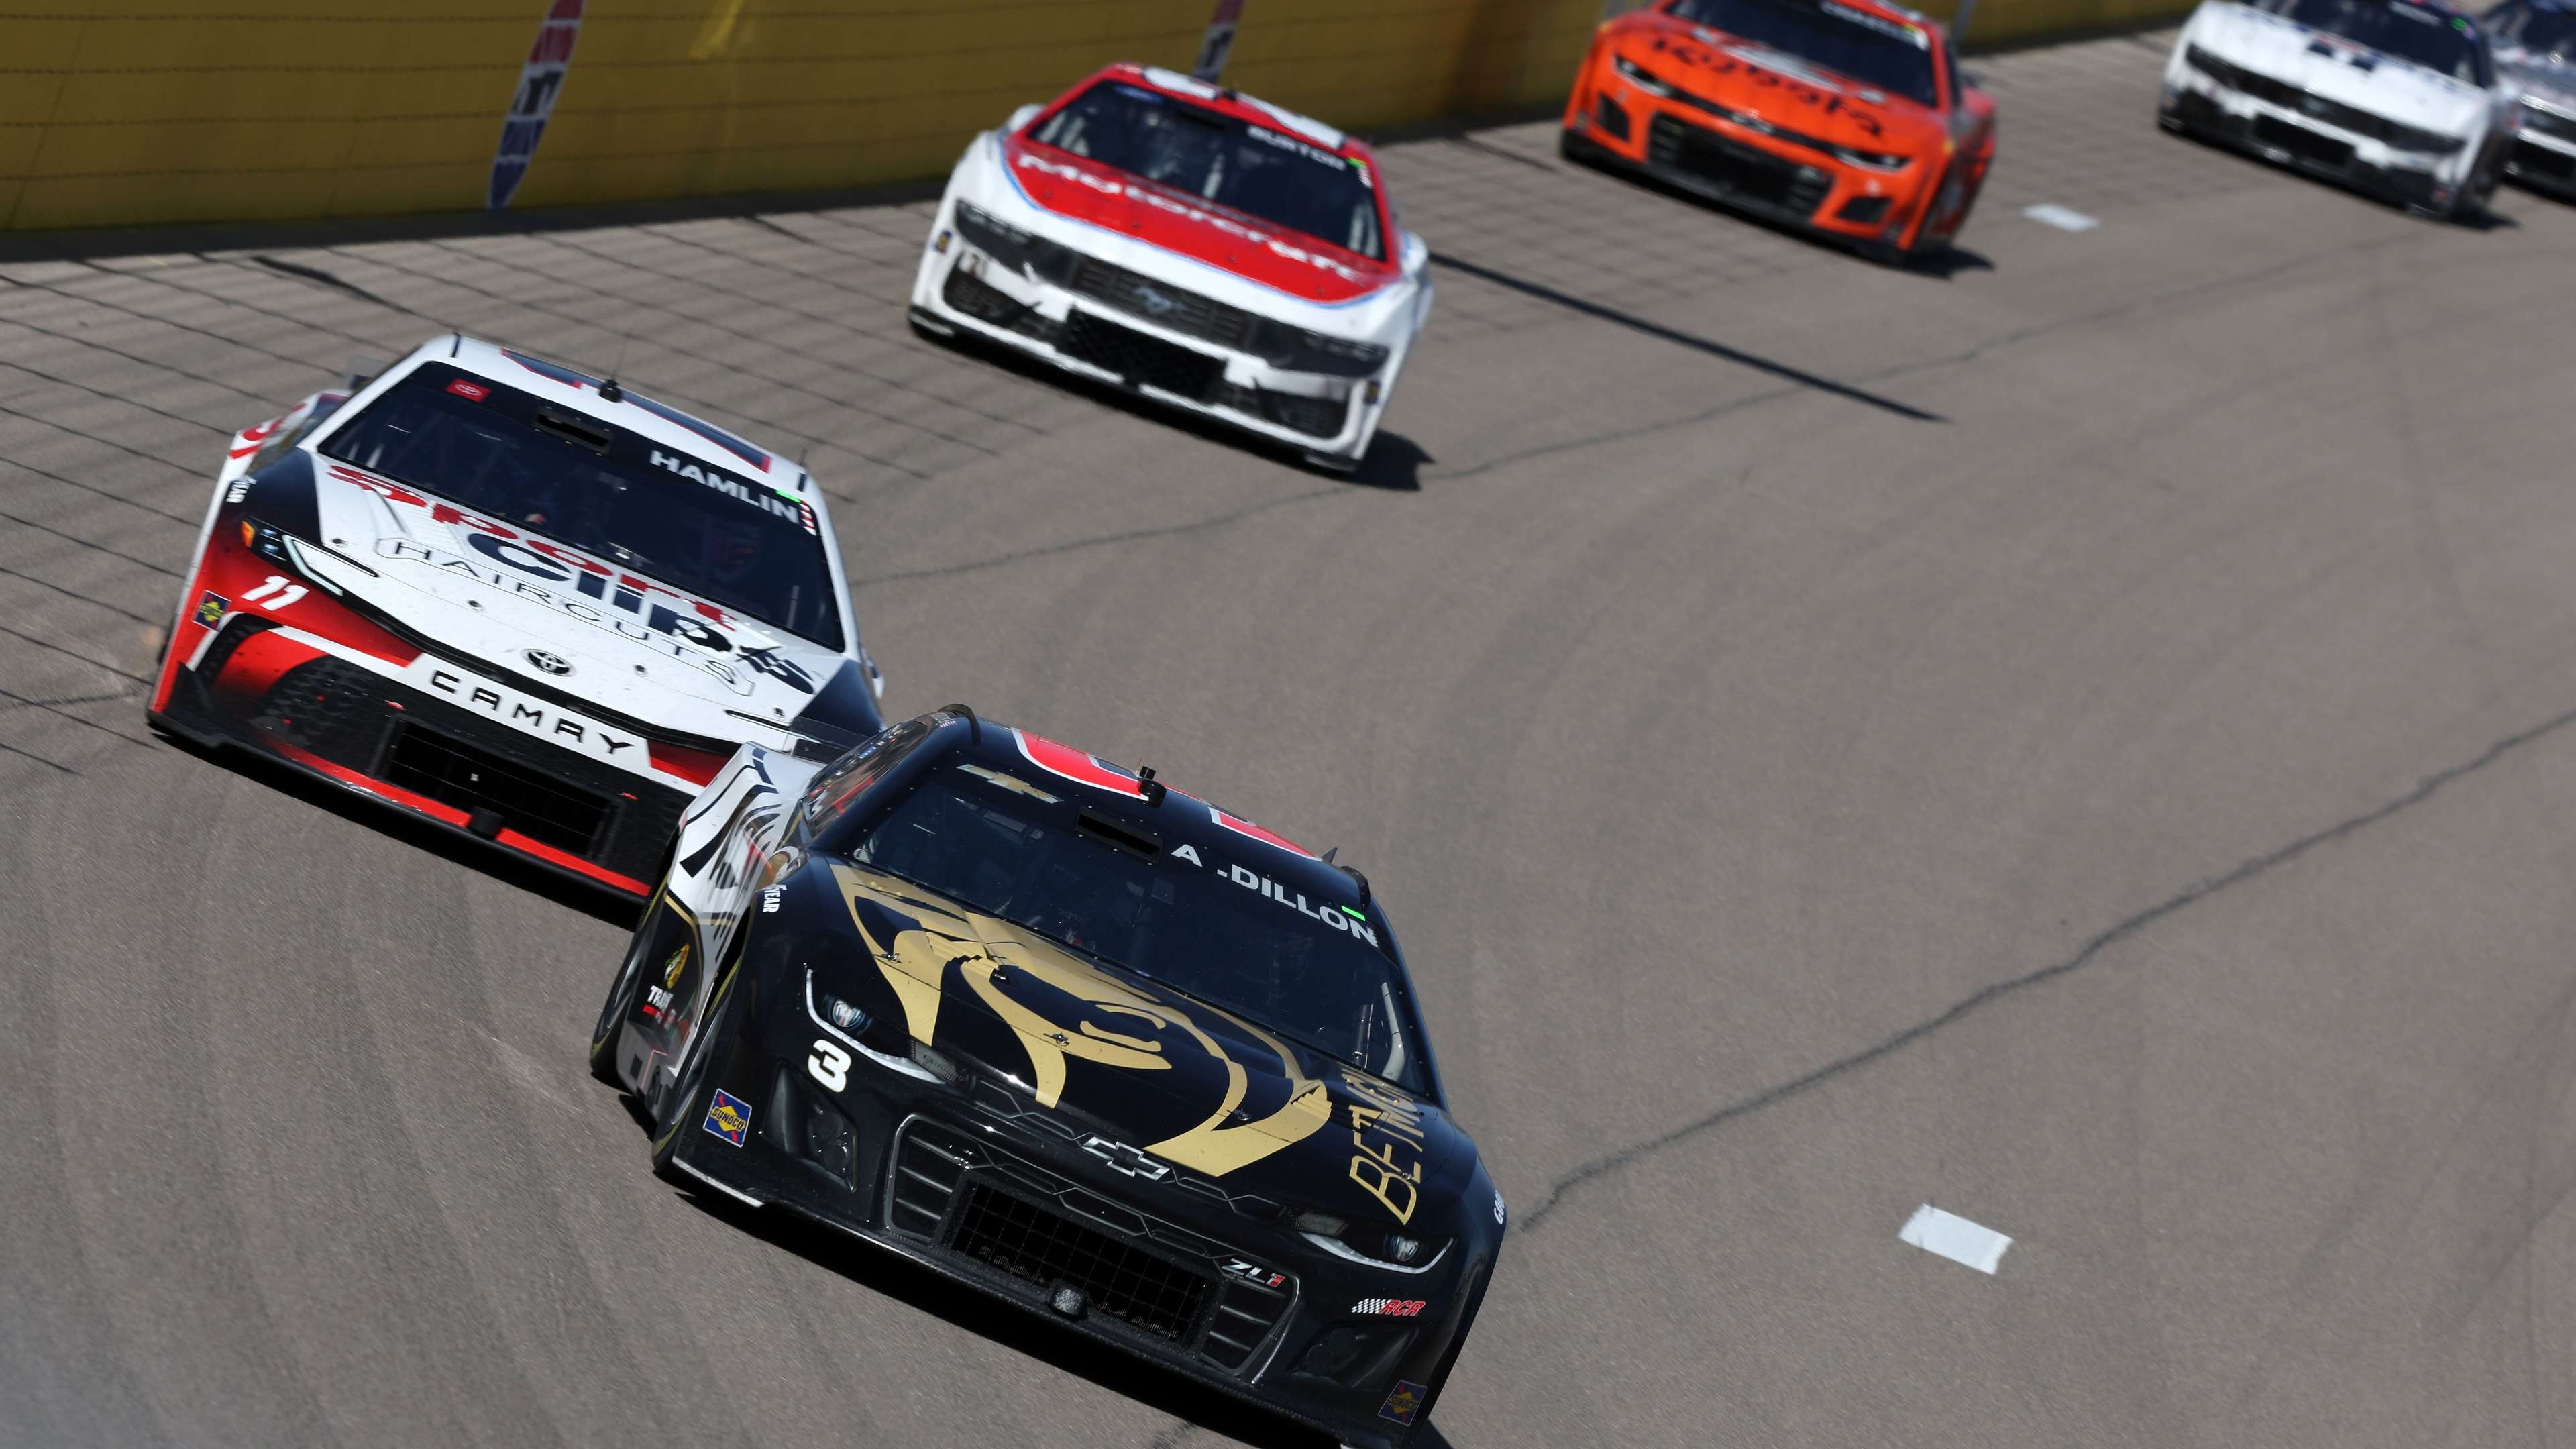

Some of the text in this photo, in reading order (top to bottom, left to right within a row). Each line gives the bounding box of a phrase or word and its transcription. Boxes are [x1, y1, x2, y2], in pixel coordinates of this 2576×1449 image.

[649, 450, 801, 524] HAMLIN
[326, 465, 739, 631] Sport
[241, 576, 309, 611] 11
[396, 541, 737, 685] HAIRCUTS
[431, 670, 633, 754] CAMRY
[808, 1039, 852, 1093] 3
[711, 1108, 745, 1130] SUNOCO
[1222, 1258, 1285, 1287] ZL1
[1378, 1299, 1426, 1317] RCR
